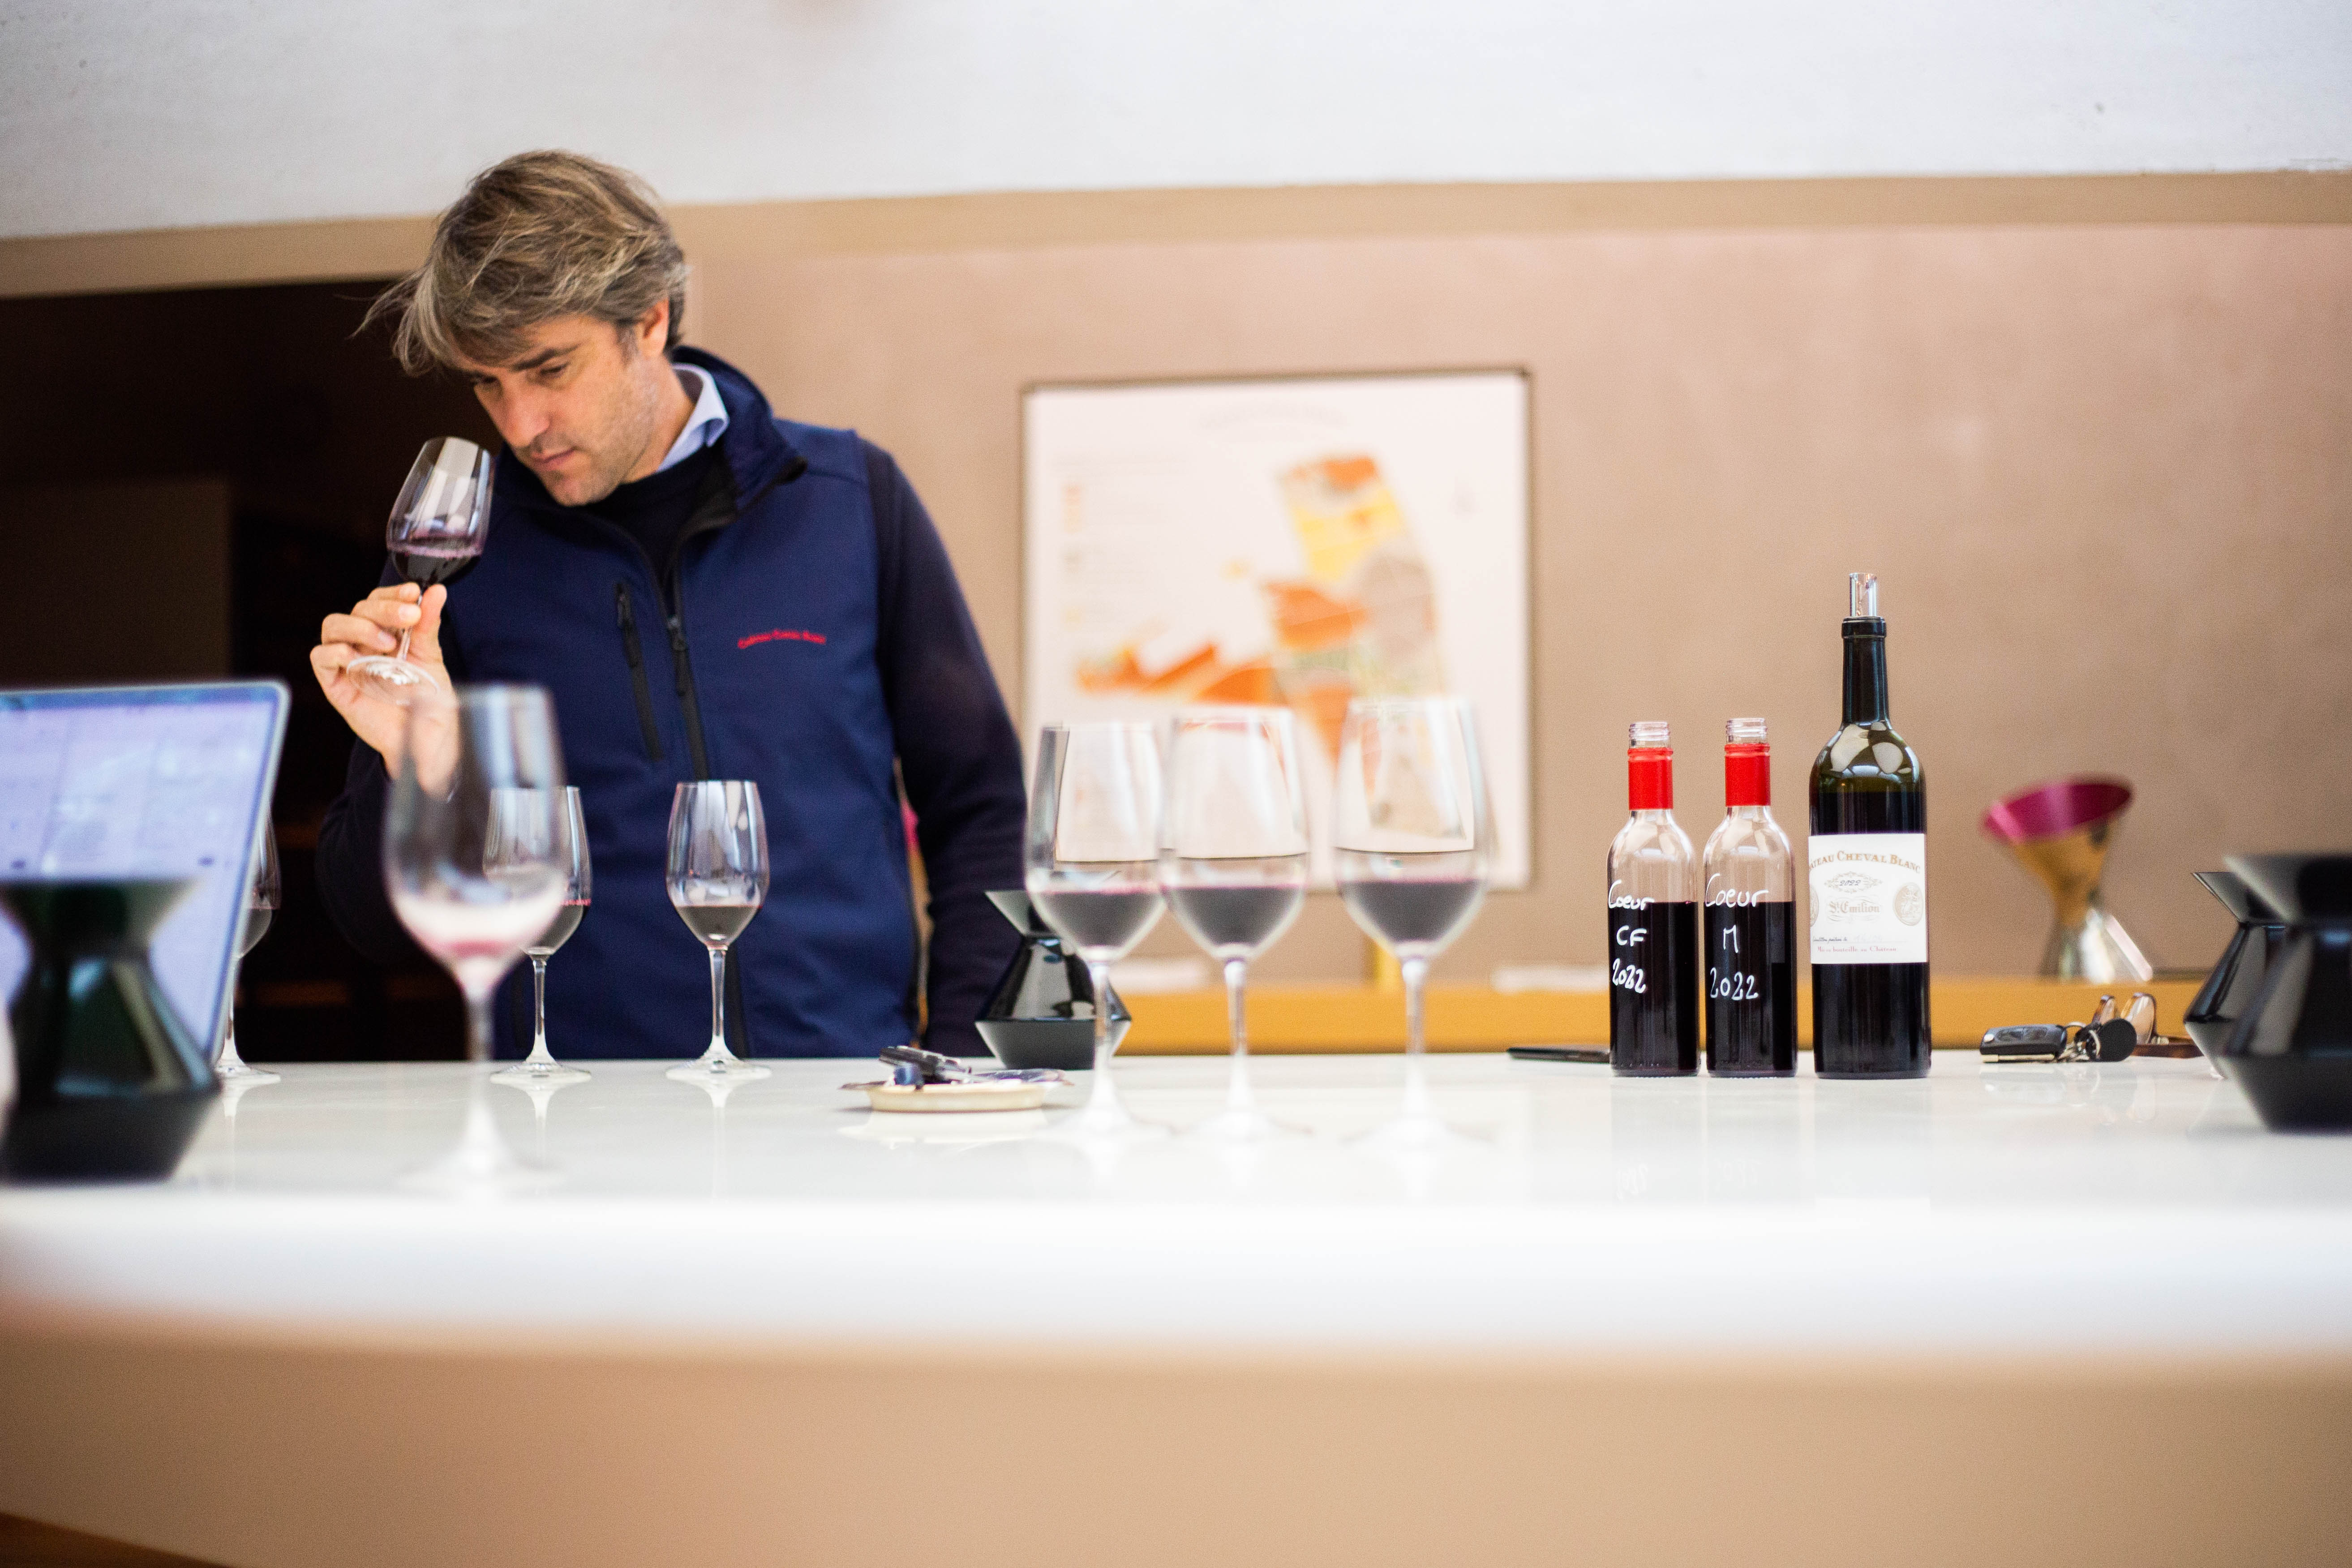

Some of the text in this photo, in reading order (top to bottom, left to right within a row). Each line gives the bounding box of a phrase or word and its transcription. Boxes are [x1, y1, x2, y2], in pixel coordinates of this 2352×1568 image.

[1837, 850, 1887, 863] CHEVAL
[1890, 854, 1920, 874] BLANC
[1608, 880, 1654, 910] Coeur
[1705, 873, 1768, 907] Coeur
[1616, 925, 1647, 946] CF
[1612, 958, 1646, 993] 2022
[1710, 967, 1759, 1001] 2022
